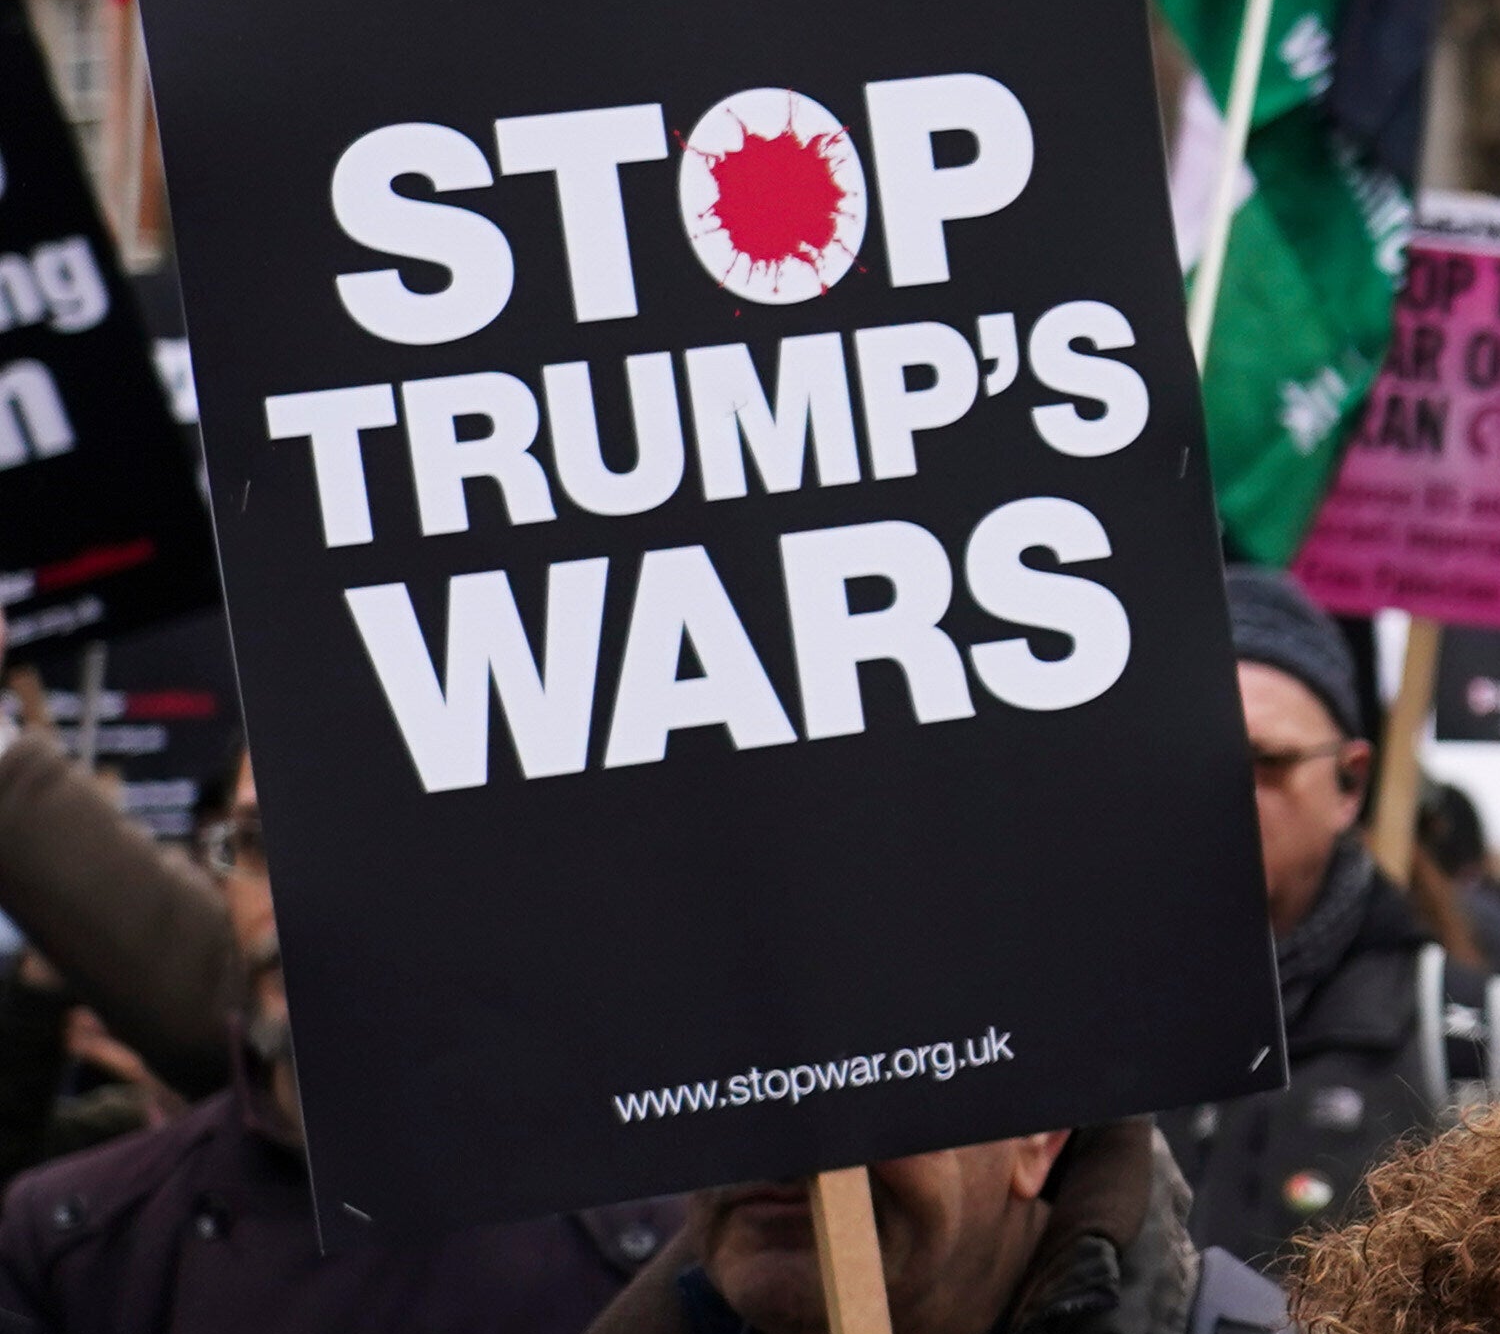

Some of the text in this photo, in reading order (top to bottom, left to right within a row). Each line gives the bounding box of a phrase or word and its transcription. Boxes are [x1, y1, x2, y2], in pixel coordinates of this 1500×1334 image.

[330, 73, 1034, 346] STOP
[264, 300, 1150, 548] TRUMP'S
[344, 497, 1131, 793] WARS
[614, 1025, 1014, 1123] www.stopwar.org.uk
